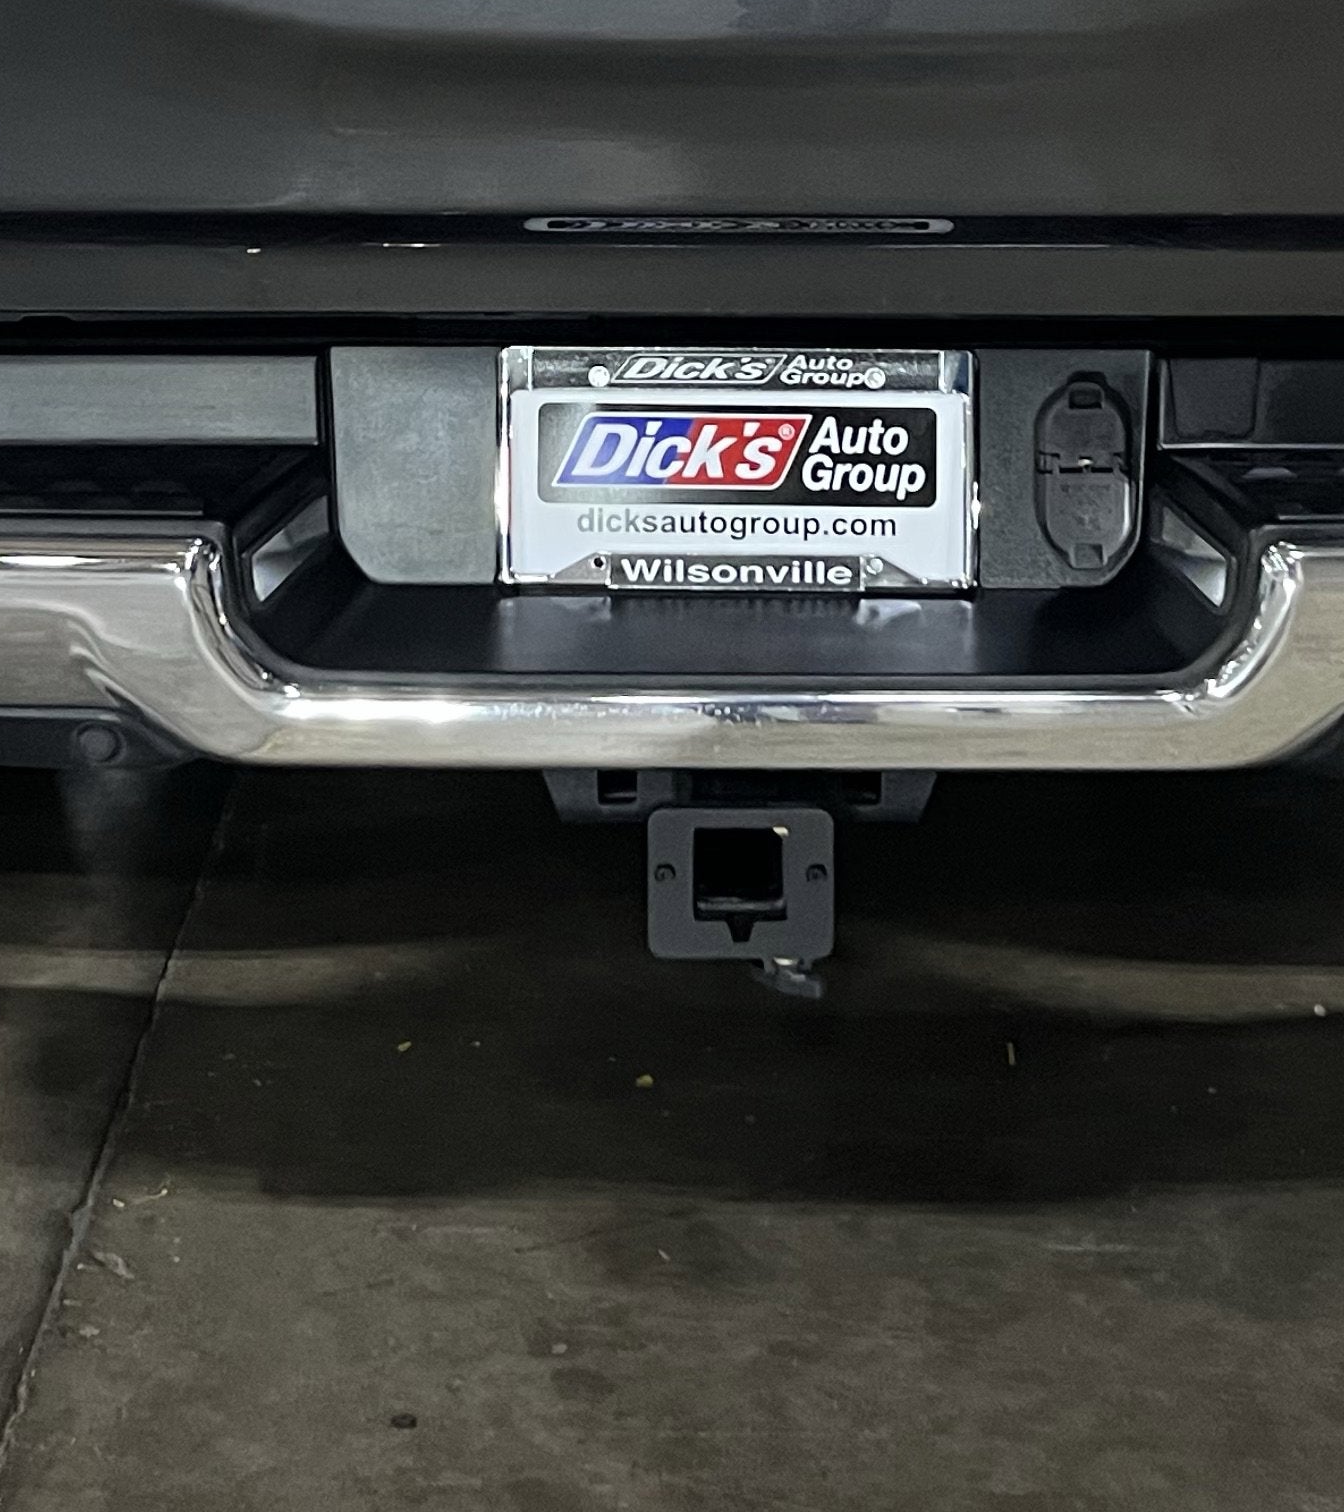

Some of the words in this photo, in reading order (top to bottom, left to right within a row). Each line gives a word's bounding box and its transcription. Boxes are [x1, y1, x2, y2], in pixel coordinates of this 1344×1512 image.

[622, 356, 767, 379] Dick's
[787, 354, 853, 370] Auto
[779, 368, 865, 387] Group
[571, 420, 782, 479] Dick's
[808, 416, 909, 456] Auto
[801, 453, 926, 500] Group
[576, 507, 897, 540] dicksautogroup.com
[620, 558, 853, 586] Wilsonville
